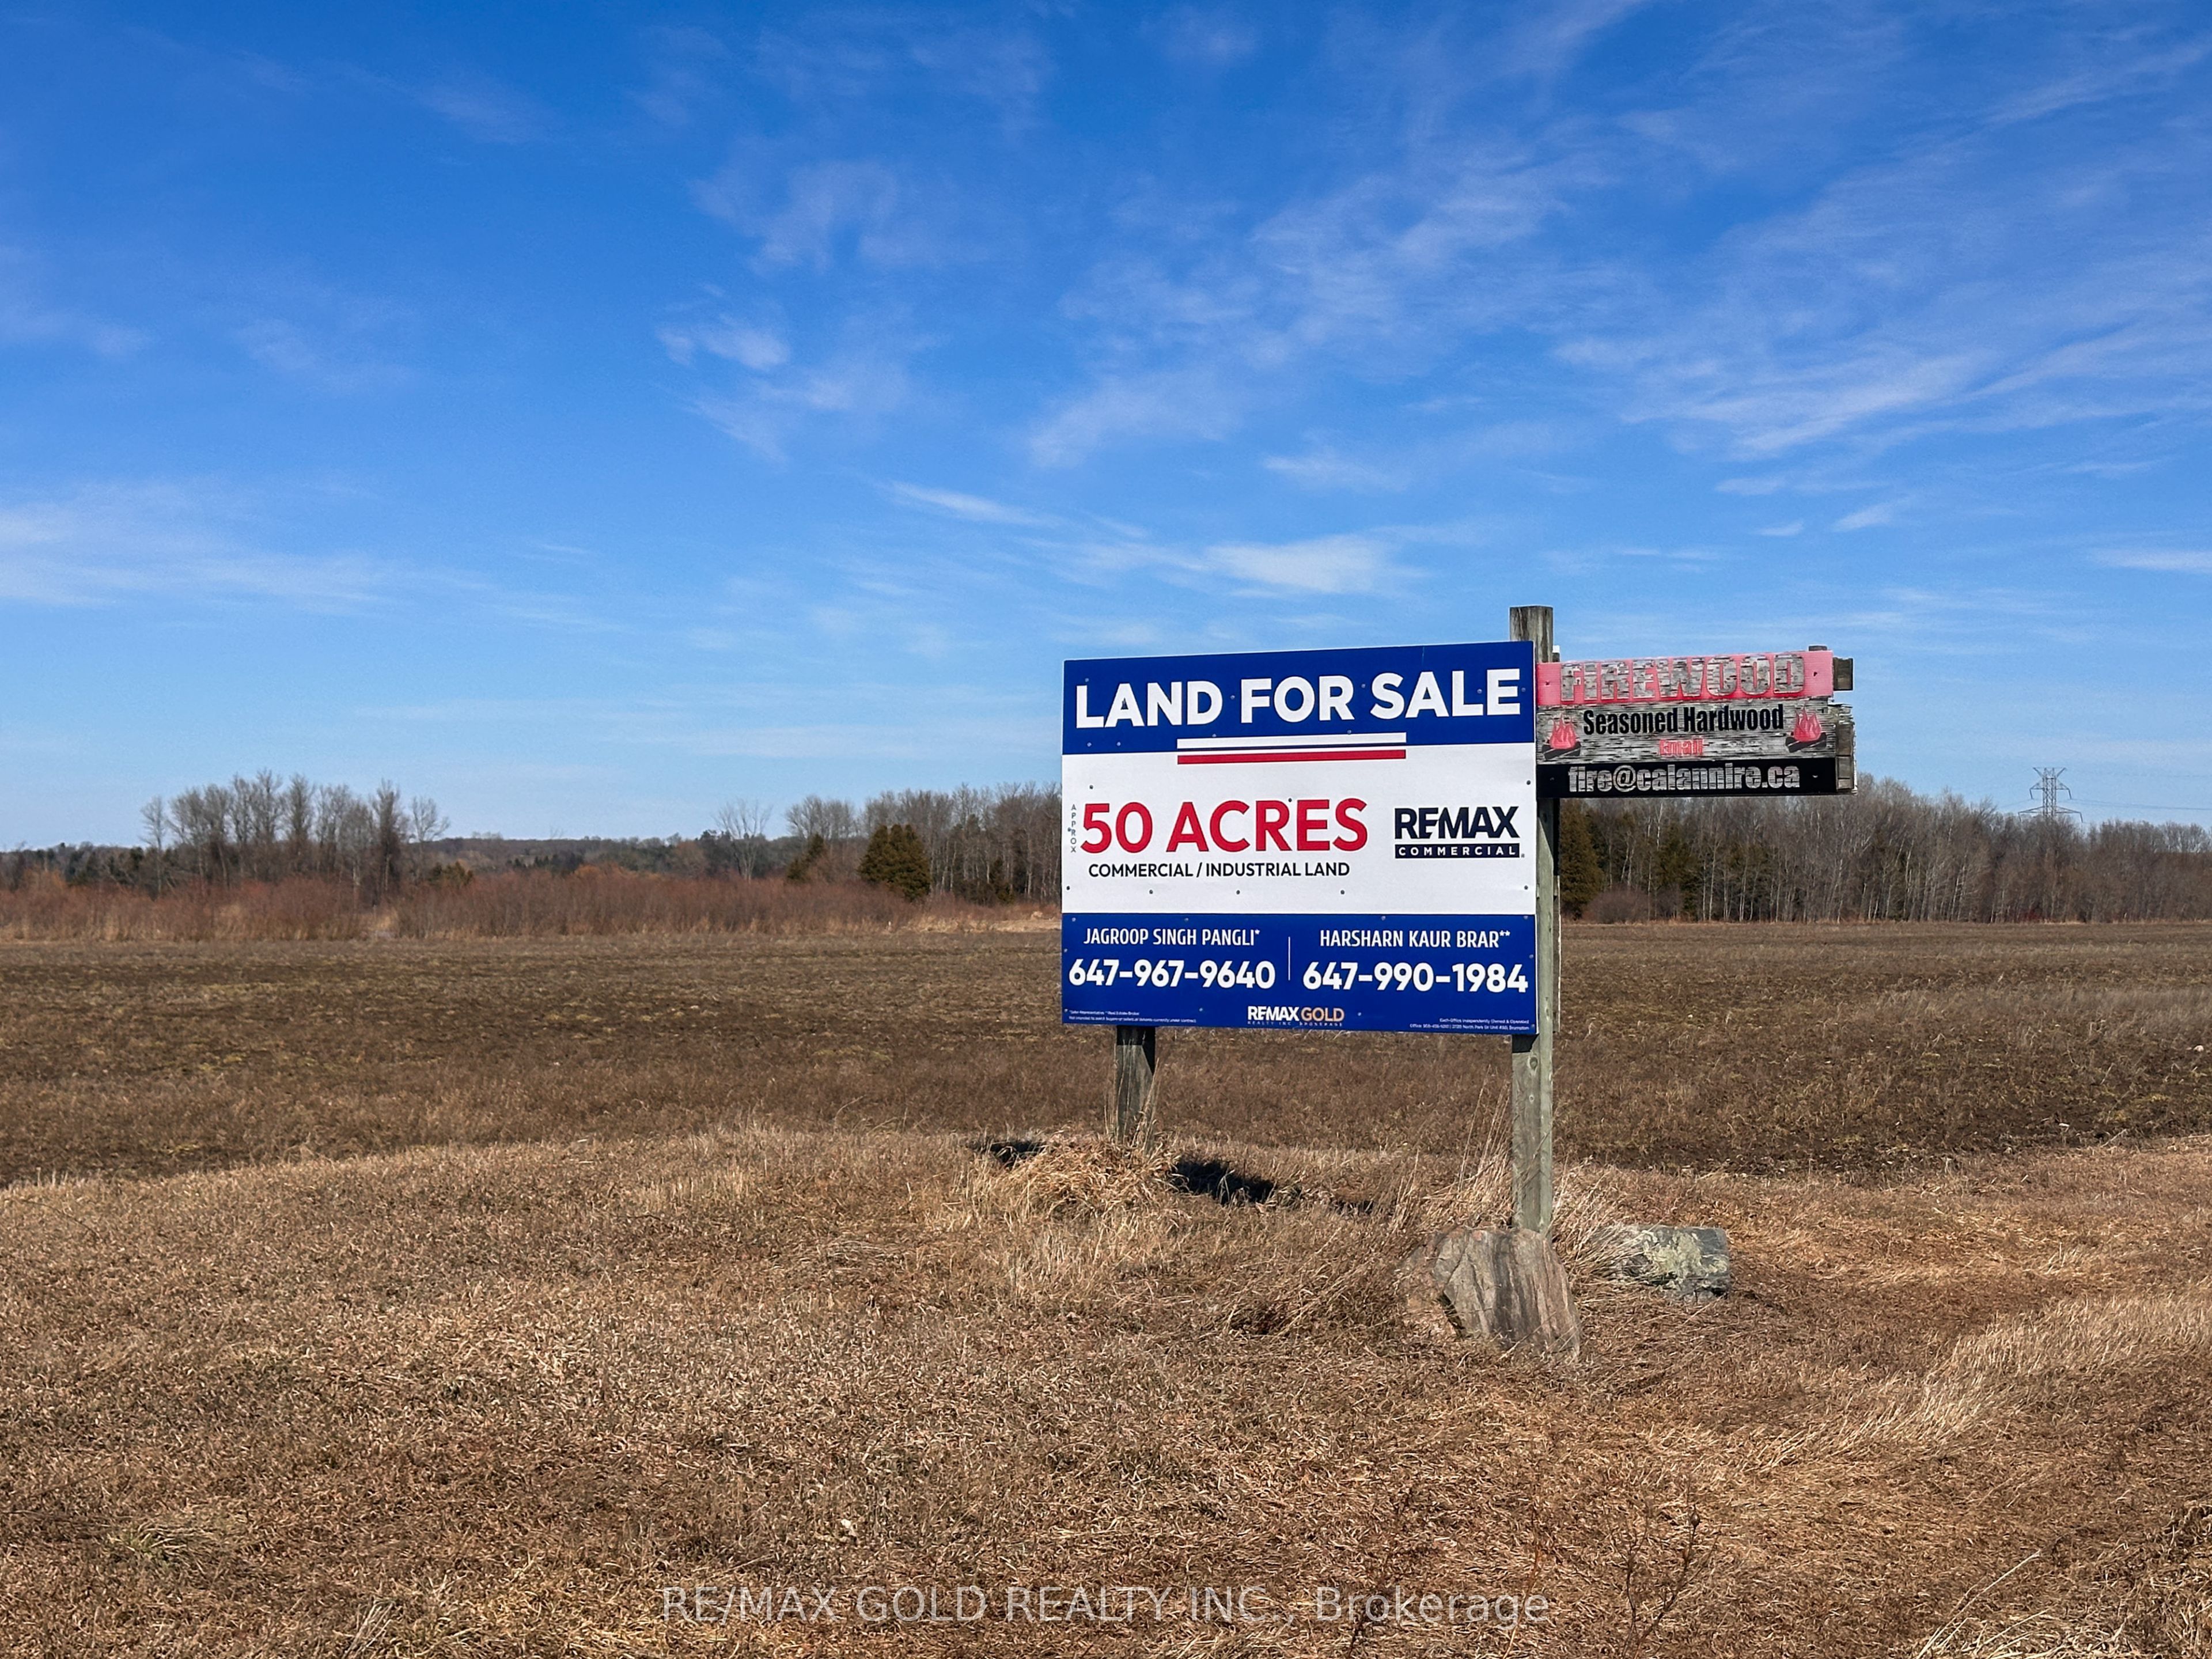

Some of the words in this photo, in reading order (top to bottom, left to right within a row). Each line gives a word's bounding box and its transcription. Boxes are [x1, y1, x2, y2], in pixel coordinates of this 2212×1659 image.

[1560, 654, 1804, 701] FIREWOOD
[1077, 681, 1222, 728] LAND
[1241, 676, 1354, 723] FOR
[1370, 669, 1520, 719] SALE
[1584, 707, 1678, 735] Seasoned
[1684, 704, 1784, 732] Hardwood
[1082, 802, 1153, 853] 50
[1167, 798, 1367, 852] ACRES
[1395, 806, 1520, 839] REMAX
[1399, 846, 1515, 855] COMMERCIAL
[1089, 863, 1193, 877] COMMERCIAL
[1196, 862, 1202, 877] /
[1207, 863, 1301, 876] INDUSTRIAL
[1305, 863, 1349, 876] LAND
[1084, 929, 1148, 944] JAGROOP
[1153, 929, 1196, 945] SINGH
[1321, 930, 1403, 946] HARSHARN
[1410, 931, 1450, 947] KAUR
[1069, 959, 1275, 988] 647-967-9640
[1304, 962, 1528, 992] 647-990-1984
[1248, 1006, 1299, 1021] REMAX
[1301, 1007, 1344, 1021] GOLD
